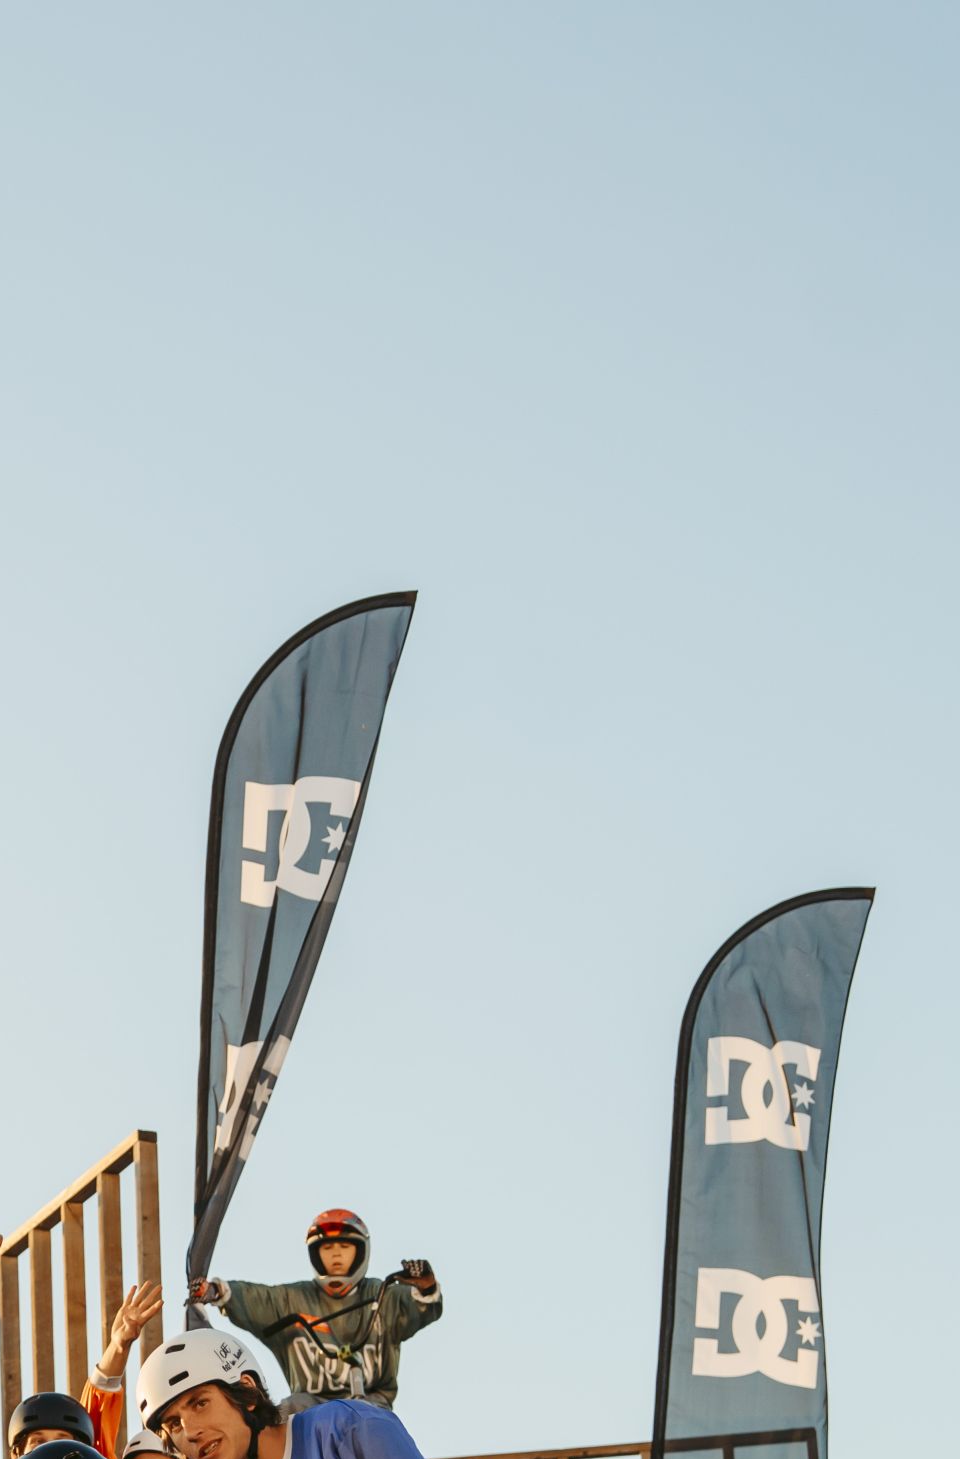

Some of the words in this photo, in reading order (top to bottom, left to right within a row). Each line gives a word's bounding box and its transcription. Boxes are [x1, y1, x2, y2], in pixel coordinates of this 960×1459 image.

[240, 776, 361, 908] DC
[705, 1036, 821, 1151] DC
[692, 1267, 821, 1389] DC
